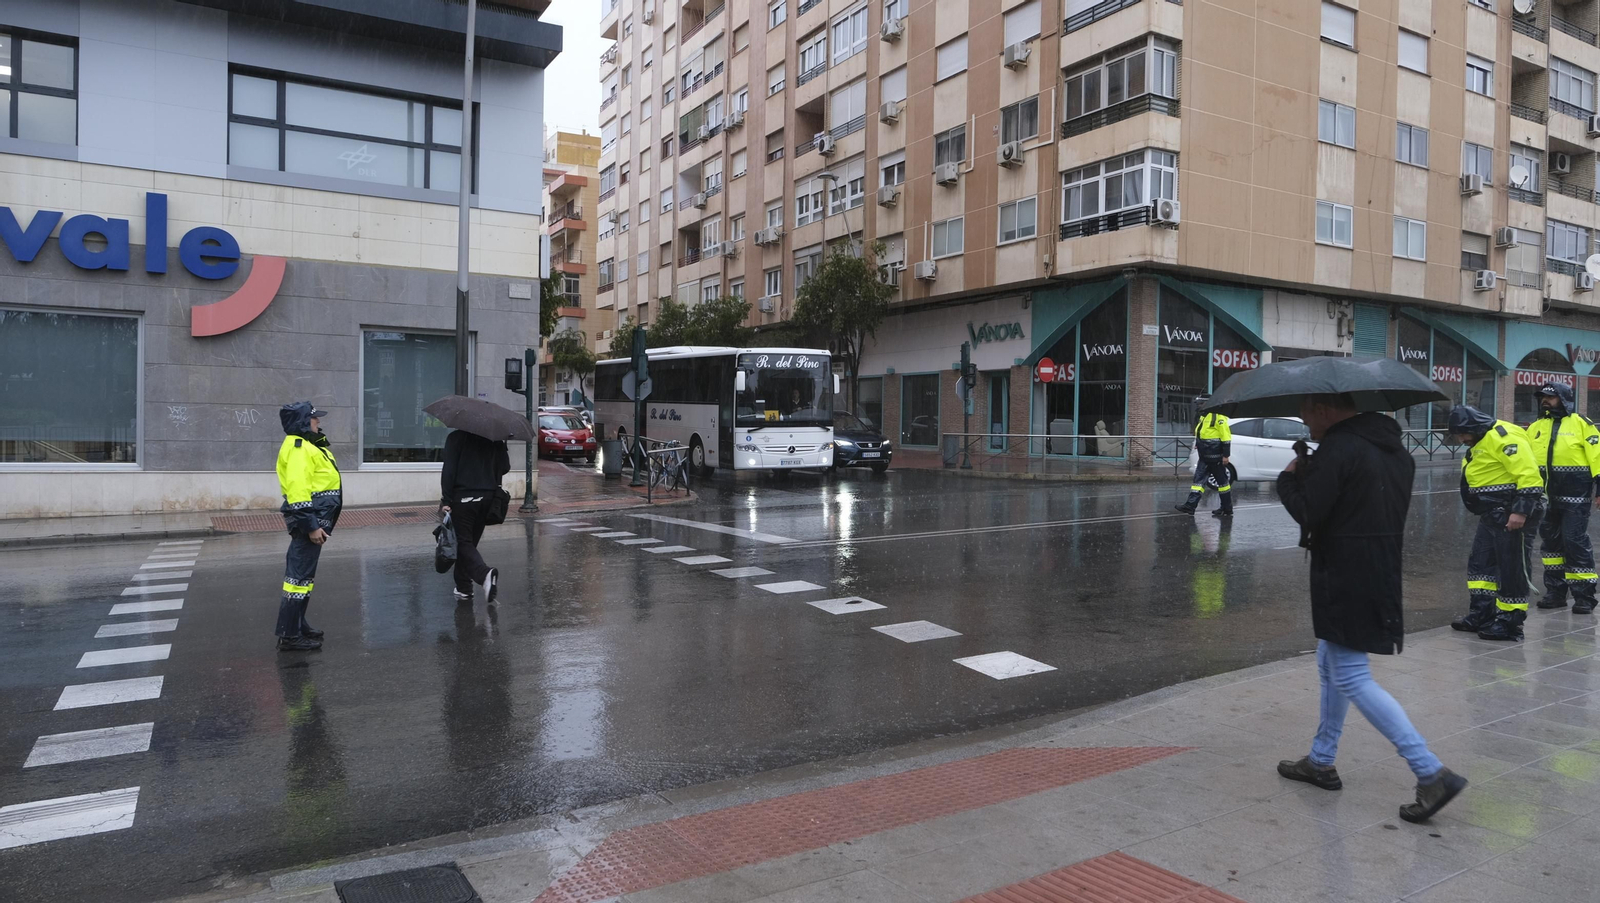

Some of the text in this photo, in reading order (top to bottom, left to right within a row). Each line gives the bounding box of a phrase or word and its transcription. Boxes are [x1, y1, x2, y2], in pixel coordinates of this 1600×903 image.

[358, 167, 377, 177] DLR
[0, 192, 241, 280] vale
[966, 321, 1025, 350] VÁNOVA
[1163, 324, 1203, 343] VÁNOVA
[1083, 343, 1124, 361] VÁNOVA
[756, 354, 771, 369] R.
[775, 355, 792, 368] del
[795, 355, 820, 369] Pino
[1034, 363, 1075, 383] SFÁS
[1517, 371, 1573, 388] COLCHONES
